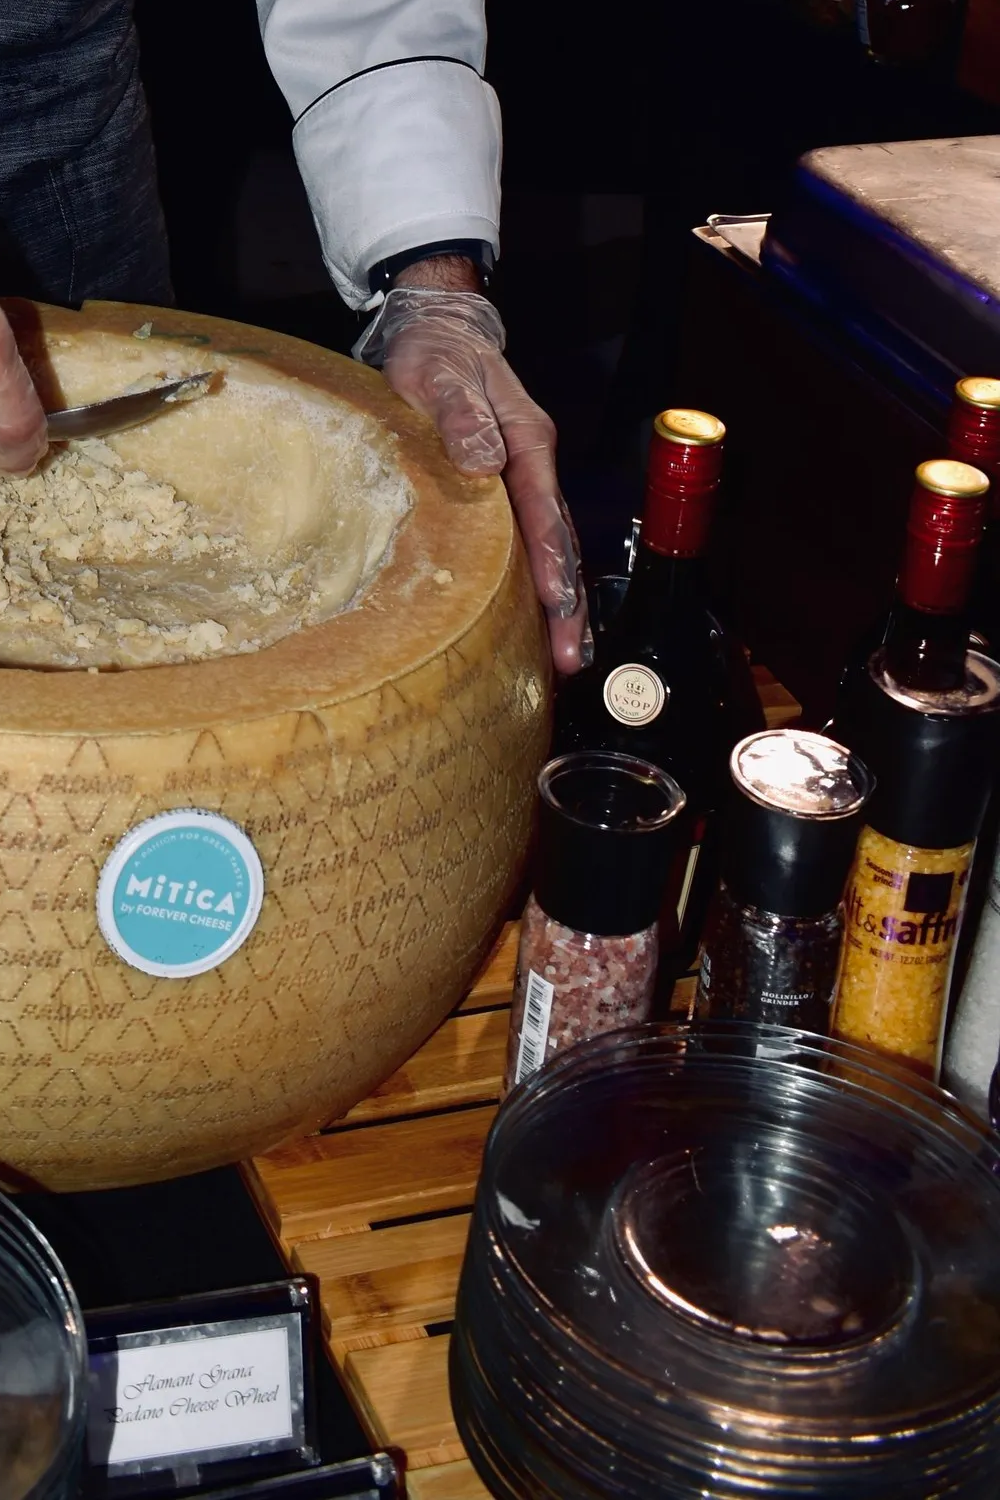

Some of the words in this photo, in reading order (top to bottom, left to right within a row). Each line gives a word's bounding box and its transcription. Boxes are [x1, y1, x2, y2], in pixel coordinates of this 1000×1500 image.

[614, 693, 651, 711] VSOP
[244, 807, 307, 837] RANA
[31, 890, 88, 912] GRA
[136, 904, 189, 924] FOREVER
[189, 914, 233, 932] CHEESE
[863, 913, 876, 935] &
[247, 919, 310, 951] DANO
[760, 997, 800, 1006] GRINDER
[761, 991, 809, 1000] MOLINILLO
[123, 1373, 195, 1400] Flamant
[199, 1364, 255, 1389] Grana
[104, 1404, 164, 1424] Padano
[169, 1397, 220, 1416] Cheese
[224, 1385, 280, 1408] Wheel
